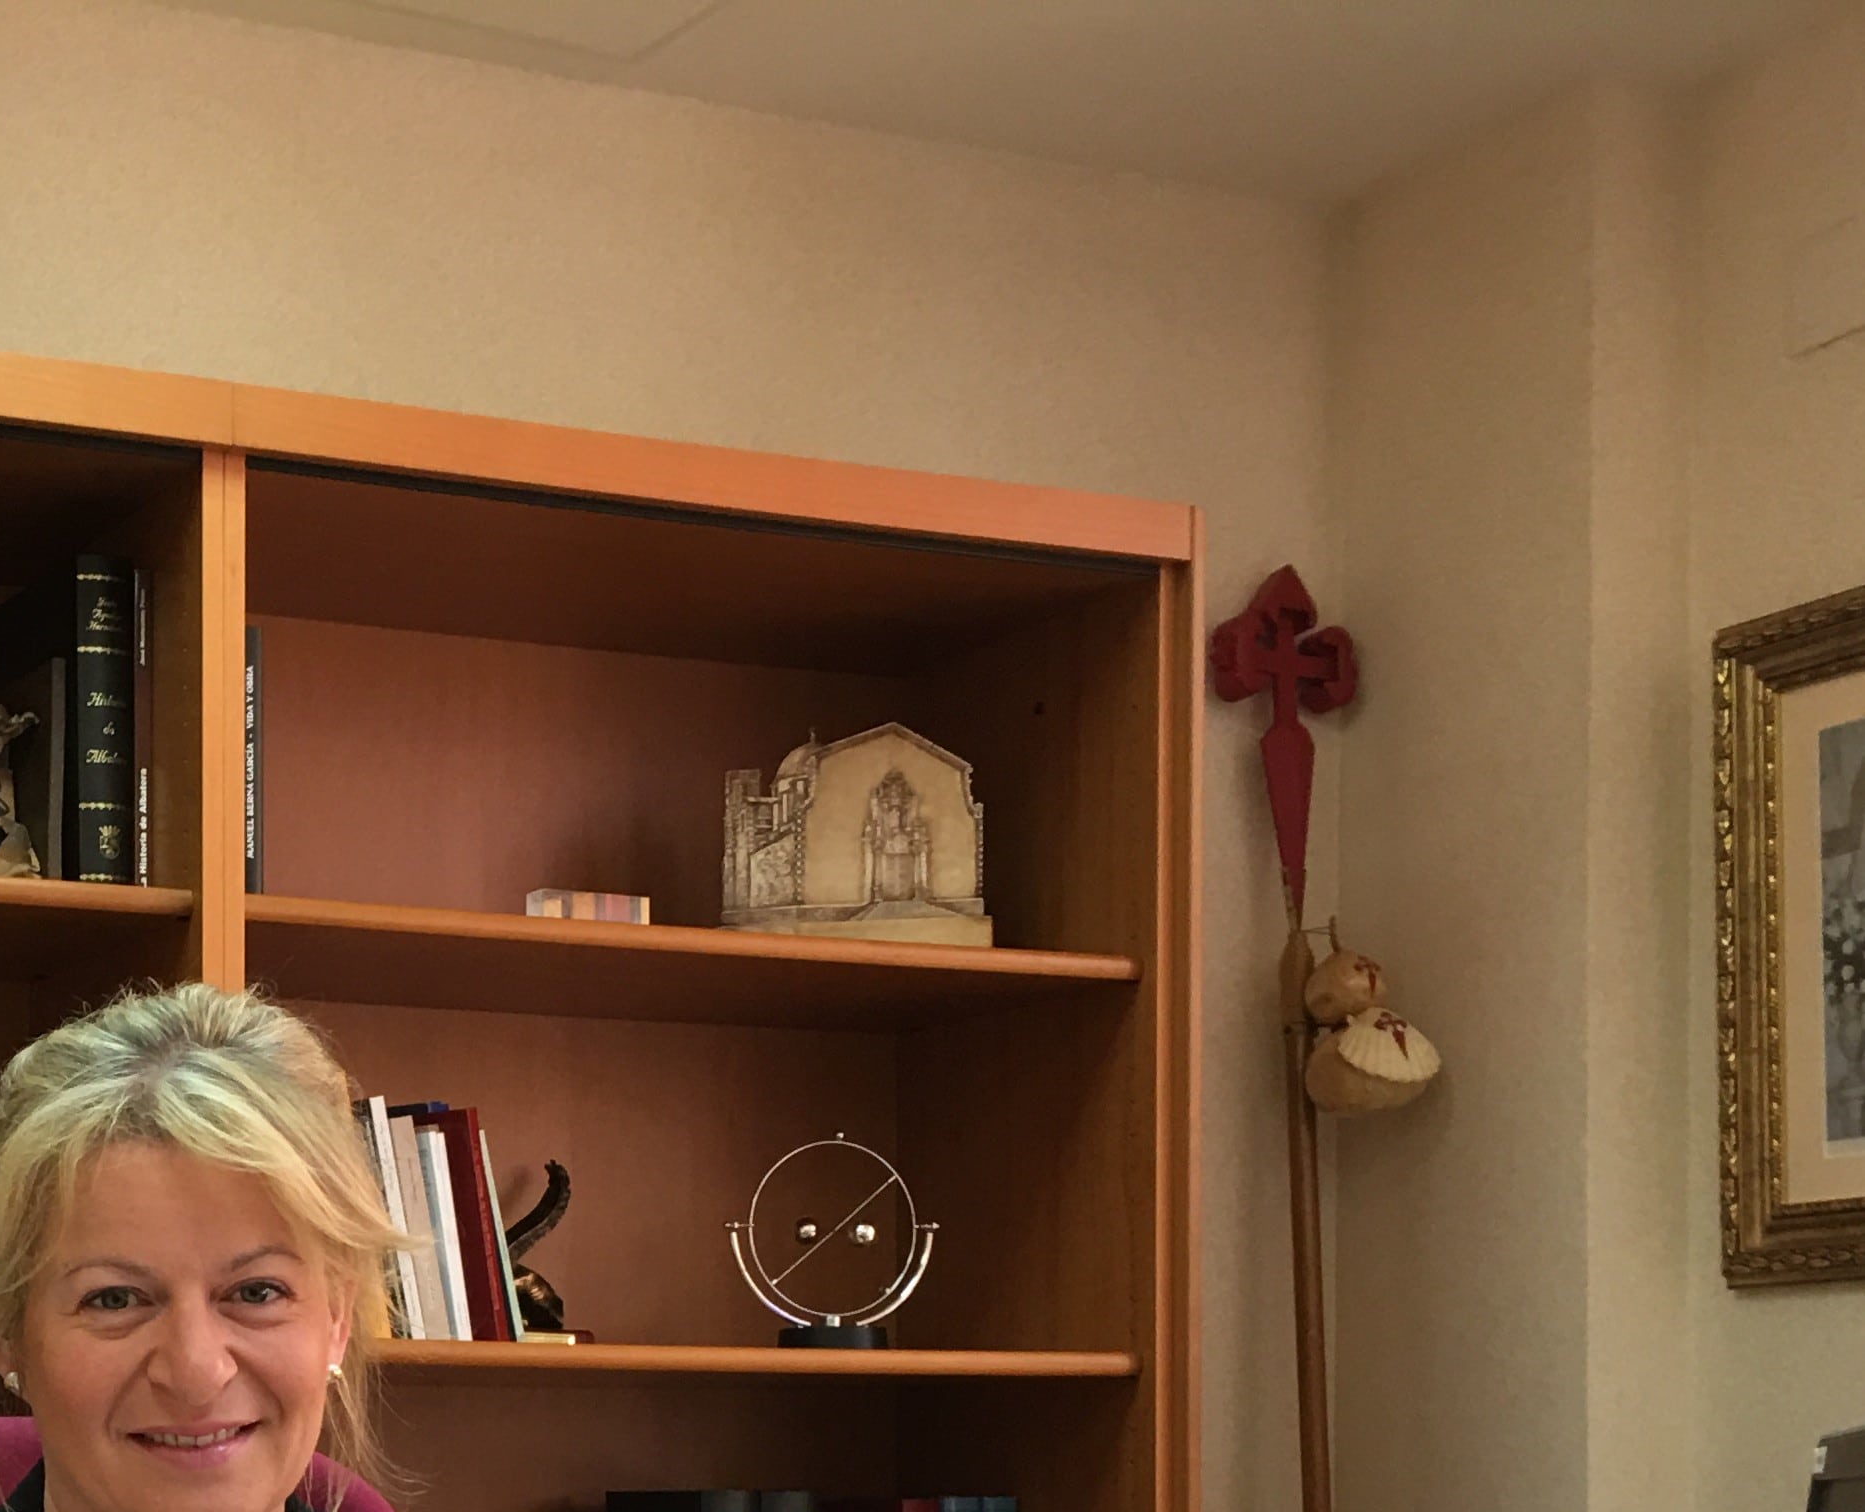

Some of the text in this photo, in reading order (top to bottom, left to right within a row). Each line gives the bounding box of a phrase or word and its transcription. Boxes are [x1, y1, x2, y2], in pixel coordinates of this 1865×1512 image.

[246, 665, 254, 694] OBRA
[246, 705, 254, 729] VIDA
[138, 768, 147, 813] Albatera
[139, 816, 147, 830] de
[246, 818, 254, 858] MANUEL
[139, 832, 147, 874] Historia
